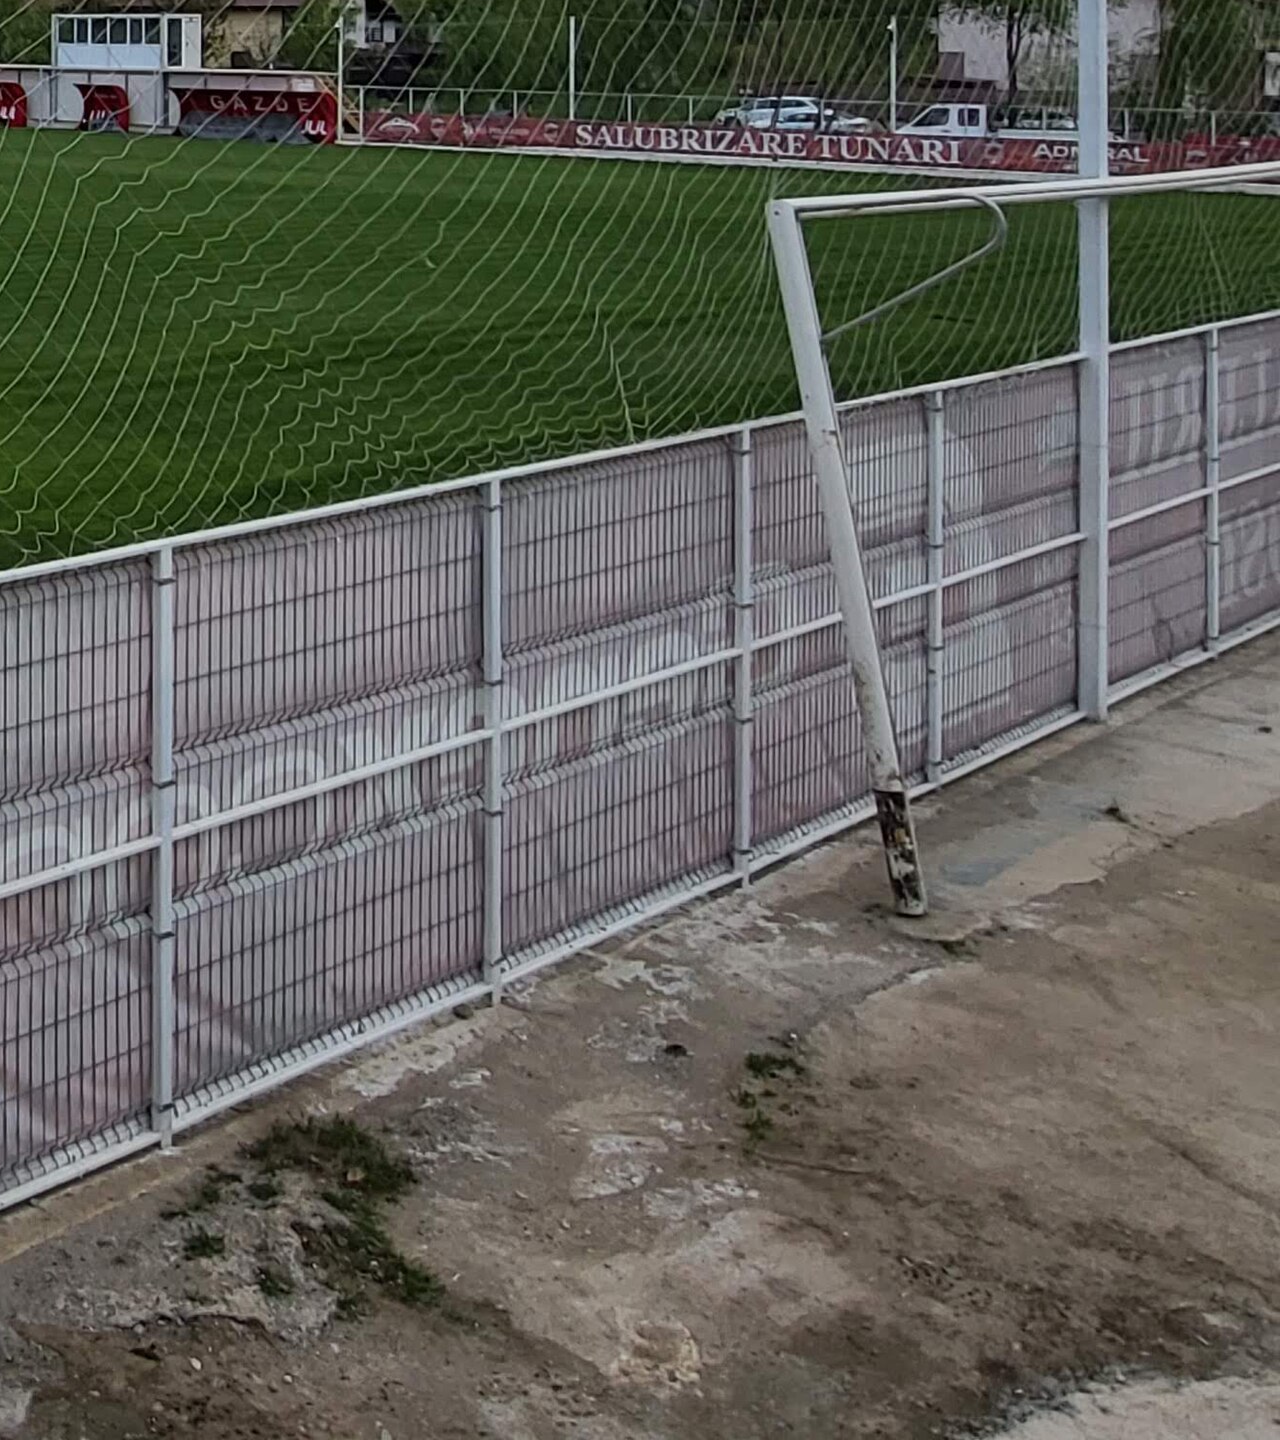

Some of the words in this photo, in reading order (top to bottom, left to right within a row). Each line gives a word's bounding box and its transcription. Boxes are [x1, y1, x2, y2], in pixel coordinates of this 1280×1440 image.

[210, 94, 313, 113] GAZDE
[575, 124, 807, 157] SALUBRIZARE
[813, 134, 962, 165] TUNARI
[1033, 142, 1151, 163] ADRAL
